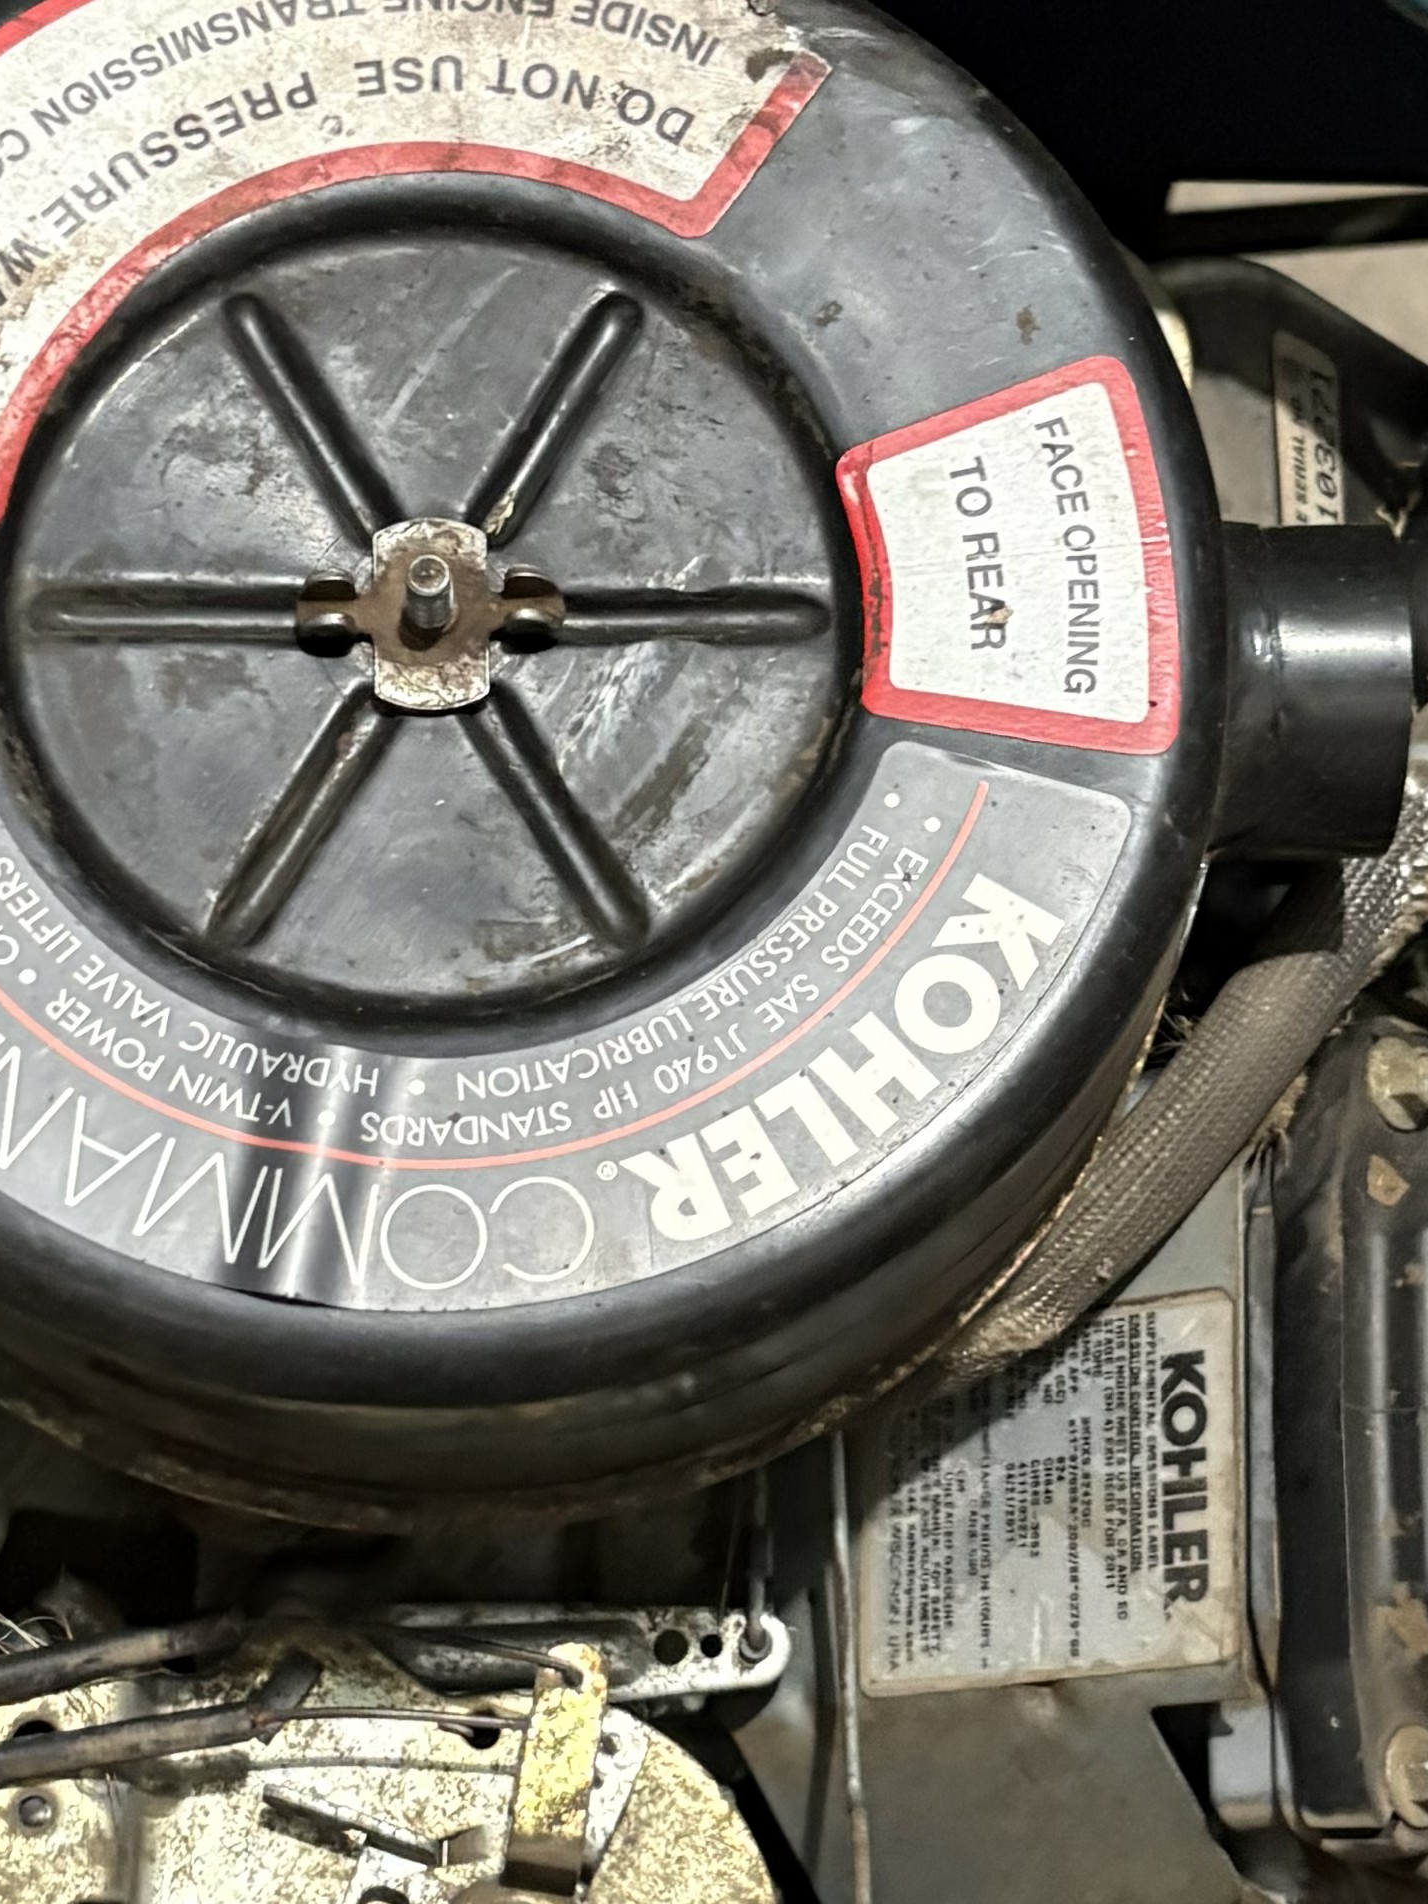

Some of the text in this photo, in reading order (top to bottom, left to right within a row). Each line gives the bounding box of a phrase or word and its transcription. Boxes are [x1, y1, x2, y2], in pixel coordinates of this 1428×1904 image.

[355, 53, 466, 101] USE
[486, 60, 605, 111] NOT
[619, 88, 695, 147] DO
[39, 69, 318, 240] PRESSURE
[948, 455, 1008, 651] TO REAR
[1033, 415, 1102, 696] FACE OPENING
[73, 953, 172, 1036] VALVE
[360, 847, 929, 1148] EXCEEDS SAE J1940 HP STANDARDS
[457, 824, 890, 1100] FULL PRESSURE LUBRICATION
[43, 988, 294, 1128] V-TWIN POWER
[178, 1020, 380, 1097] HYDRAULIC
[618, 872, 1066, 1244] KOHLER
[1114, 1317, 1126, 1348] THIS
[1115, 1355, 1127, 1411] ENGINE
[1116, 1416, 1127, 1466] MEETS
[1128, 1313, 1143, 1573] EMISSION CONTROL INFORMATION
[1145, 1311, 1160, 1572] SUPPLEMENTAL EMISSIONS LABEL
[1160, 1349, 1209, 1610] KOHLER
[1105, 1553, 1116, 1590] 2011
[1117, 1564, 1128, 1595] AND
